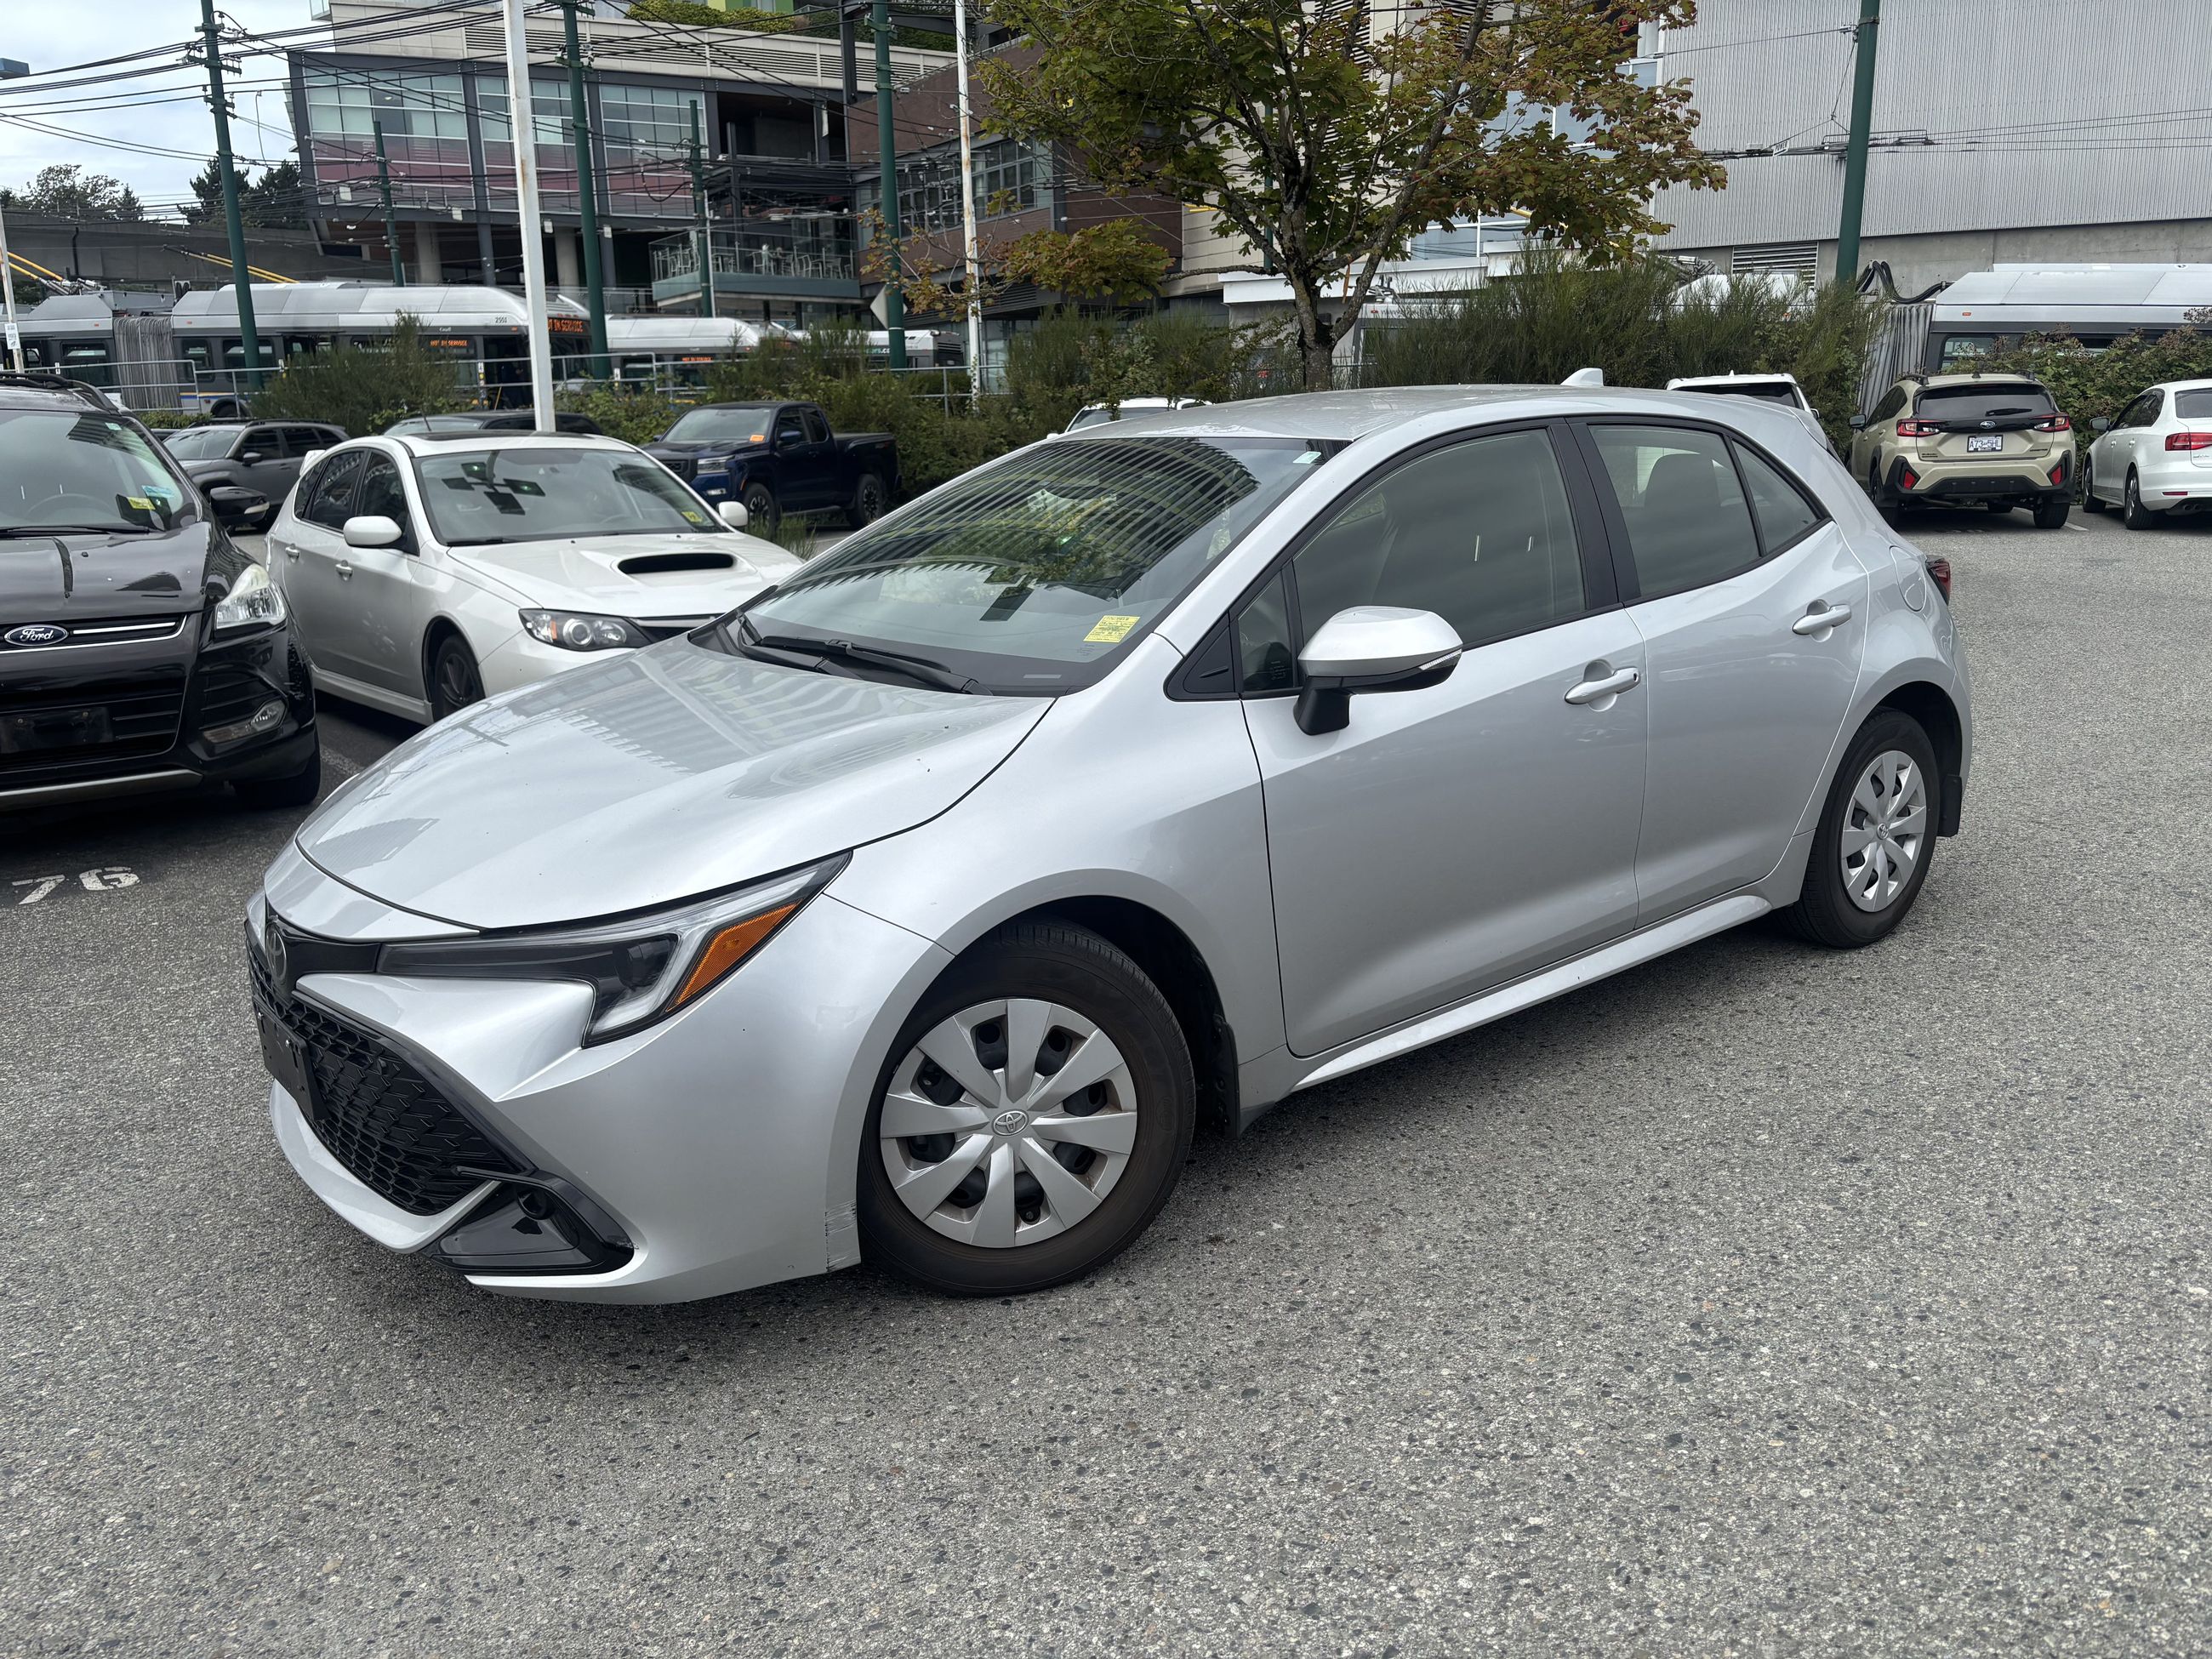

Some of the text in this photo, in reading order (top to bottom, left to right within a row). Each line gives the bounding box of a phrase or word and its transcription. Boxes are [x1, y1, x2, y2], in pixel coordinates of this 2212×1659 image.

[561, 319, 584, 333] SERVICE
[20, 628, 54, 641] Ford
[12, 866, 140, 905] 76
